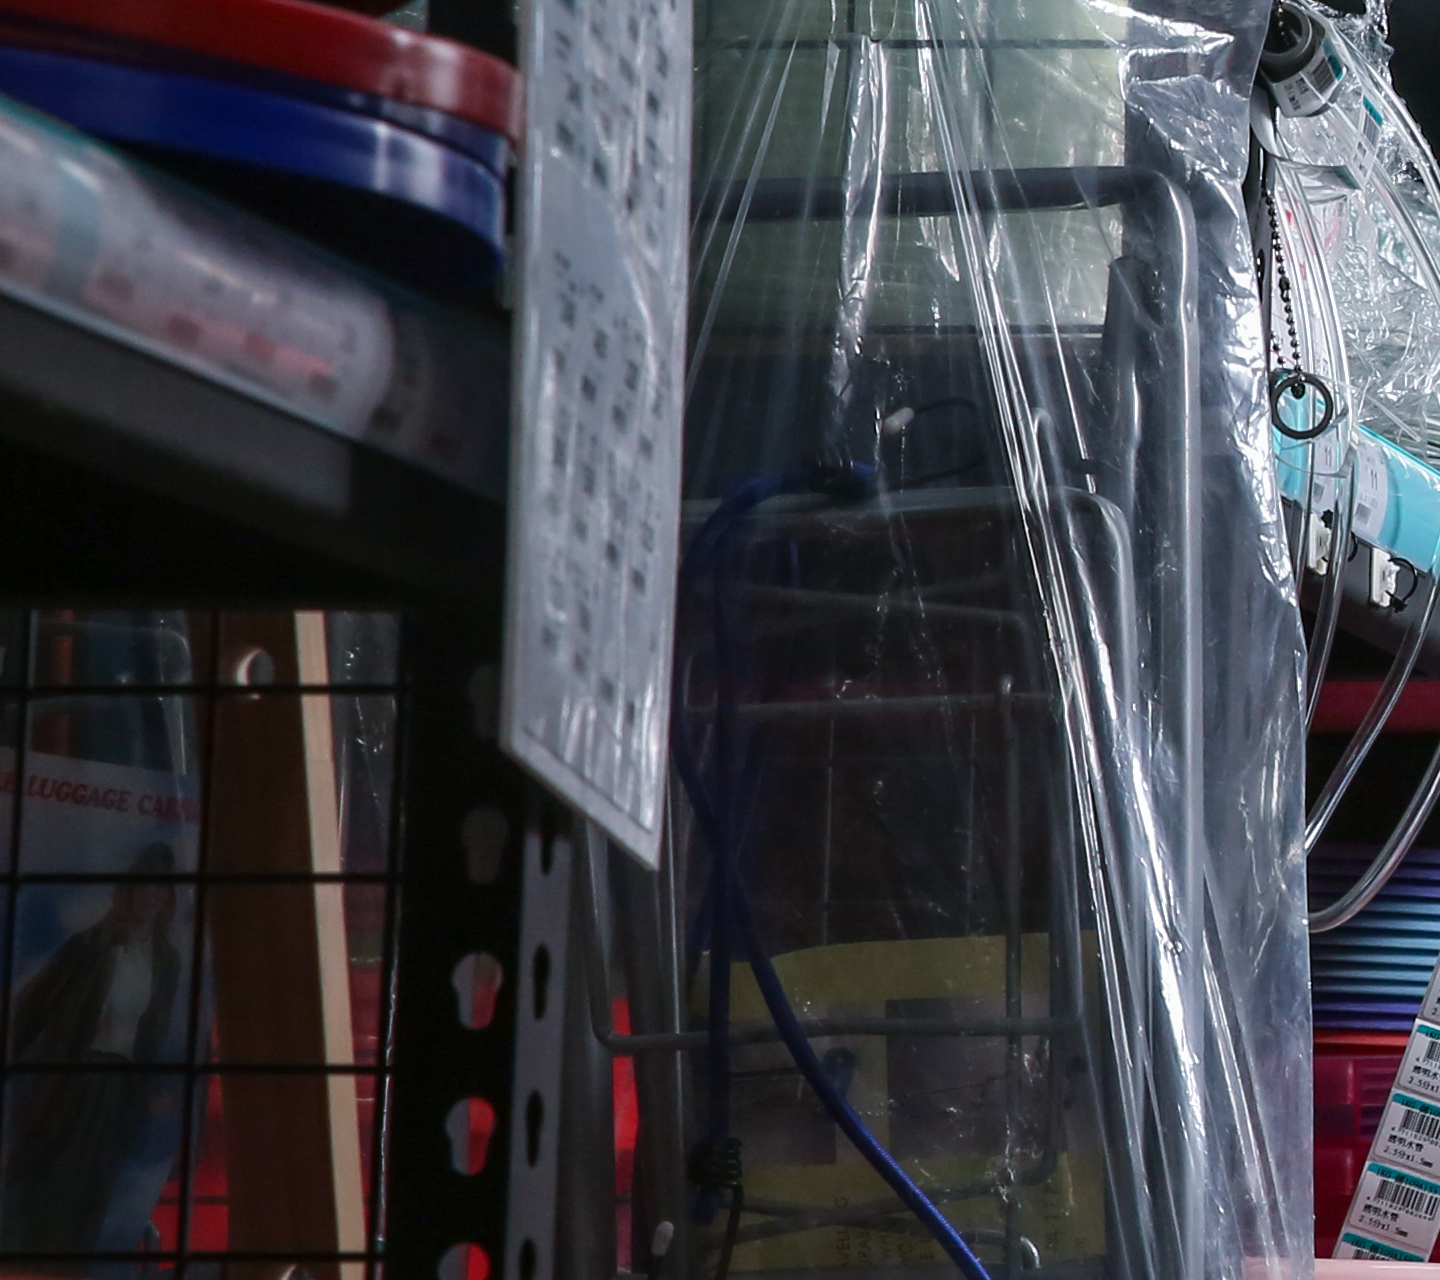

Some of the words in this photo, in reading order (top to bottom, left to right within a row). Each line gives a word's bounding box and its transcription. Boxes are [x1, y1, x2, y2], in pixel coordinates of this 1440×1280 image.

[27, 774, 132, 813] LUGGAGE
[1387, 1133, 1424, 1153] 透明水管
[1363, 1203, 1399, 1222] 透明水管
